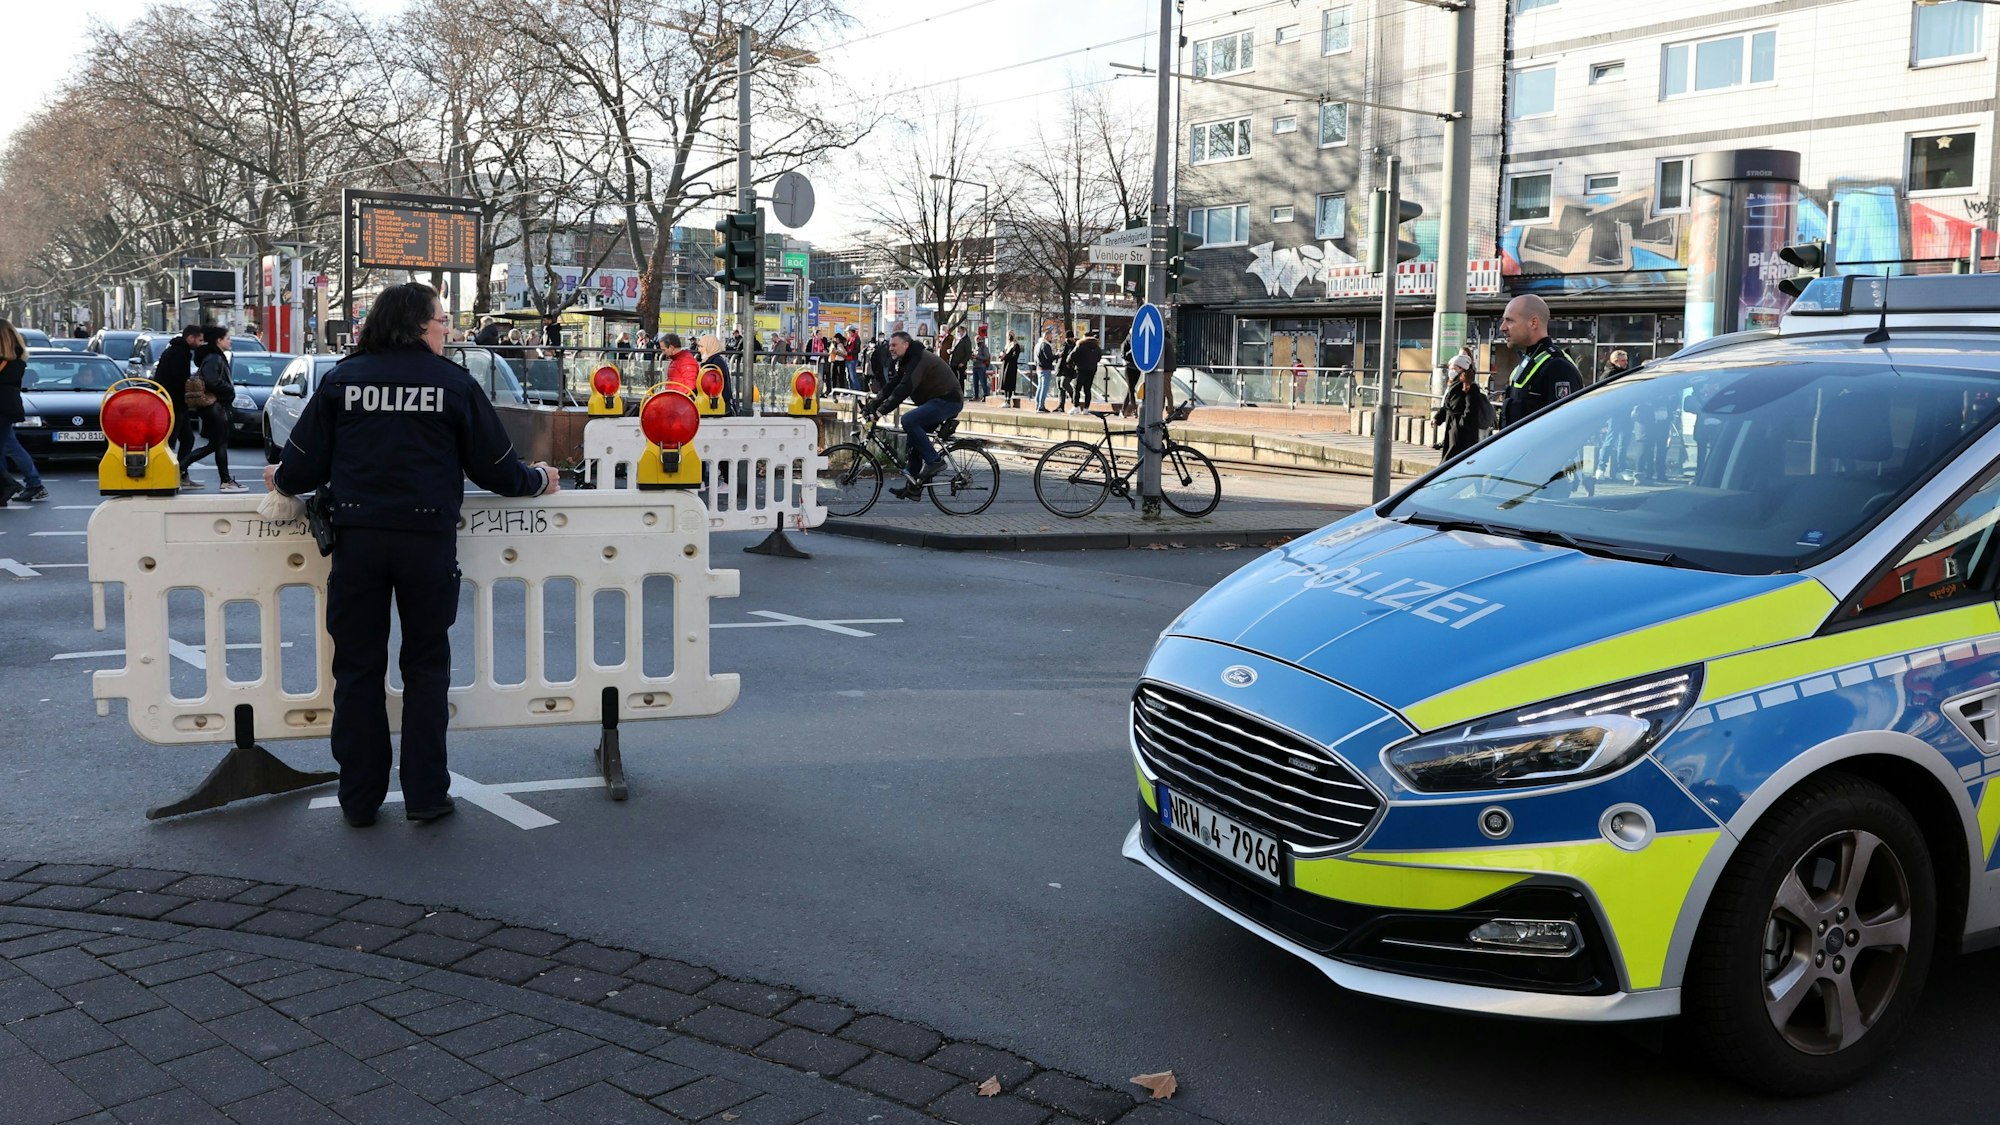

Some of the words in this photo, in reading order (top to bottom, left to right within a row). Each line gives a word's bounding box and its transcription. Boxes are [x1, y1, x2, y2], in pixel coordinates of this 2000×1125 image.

[1105, 229, 1148, 247] Ehrenfeldgürtel
[1094, 249, 1128, 261] Venloer
[1130, 250, 1146, 262] Str.
[898, 301, 905, 311] 3
[697, 316, 714, 325] MFO
[345, 385, 444, 412] POLIZEI
[88, 432, 104, 440] 810
[1268, 563, 1505, 630] POLIZEI
[1228, 670, 1249, 682] Ford
[1168, 792, 1200, 838] NRW
[1211, 815, 1280, 878] 4-7966
